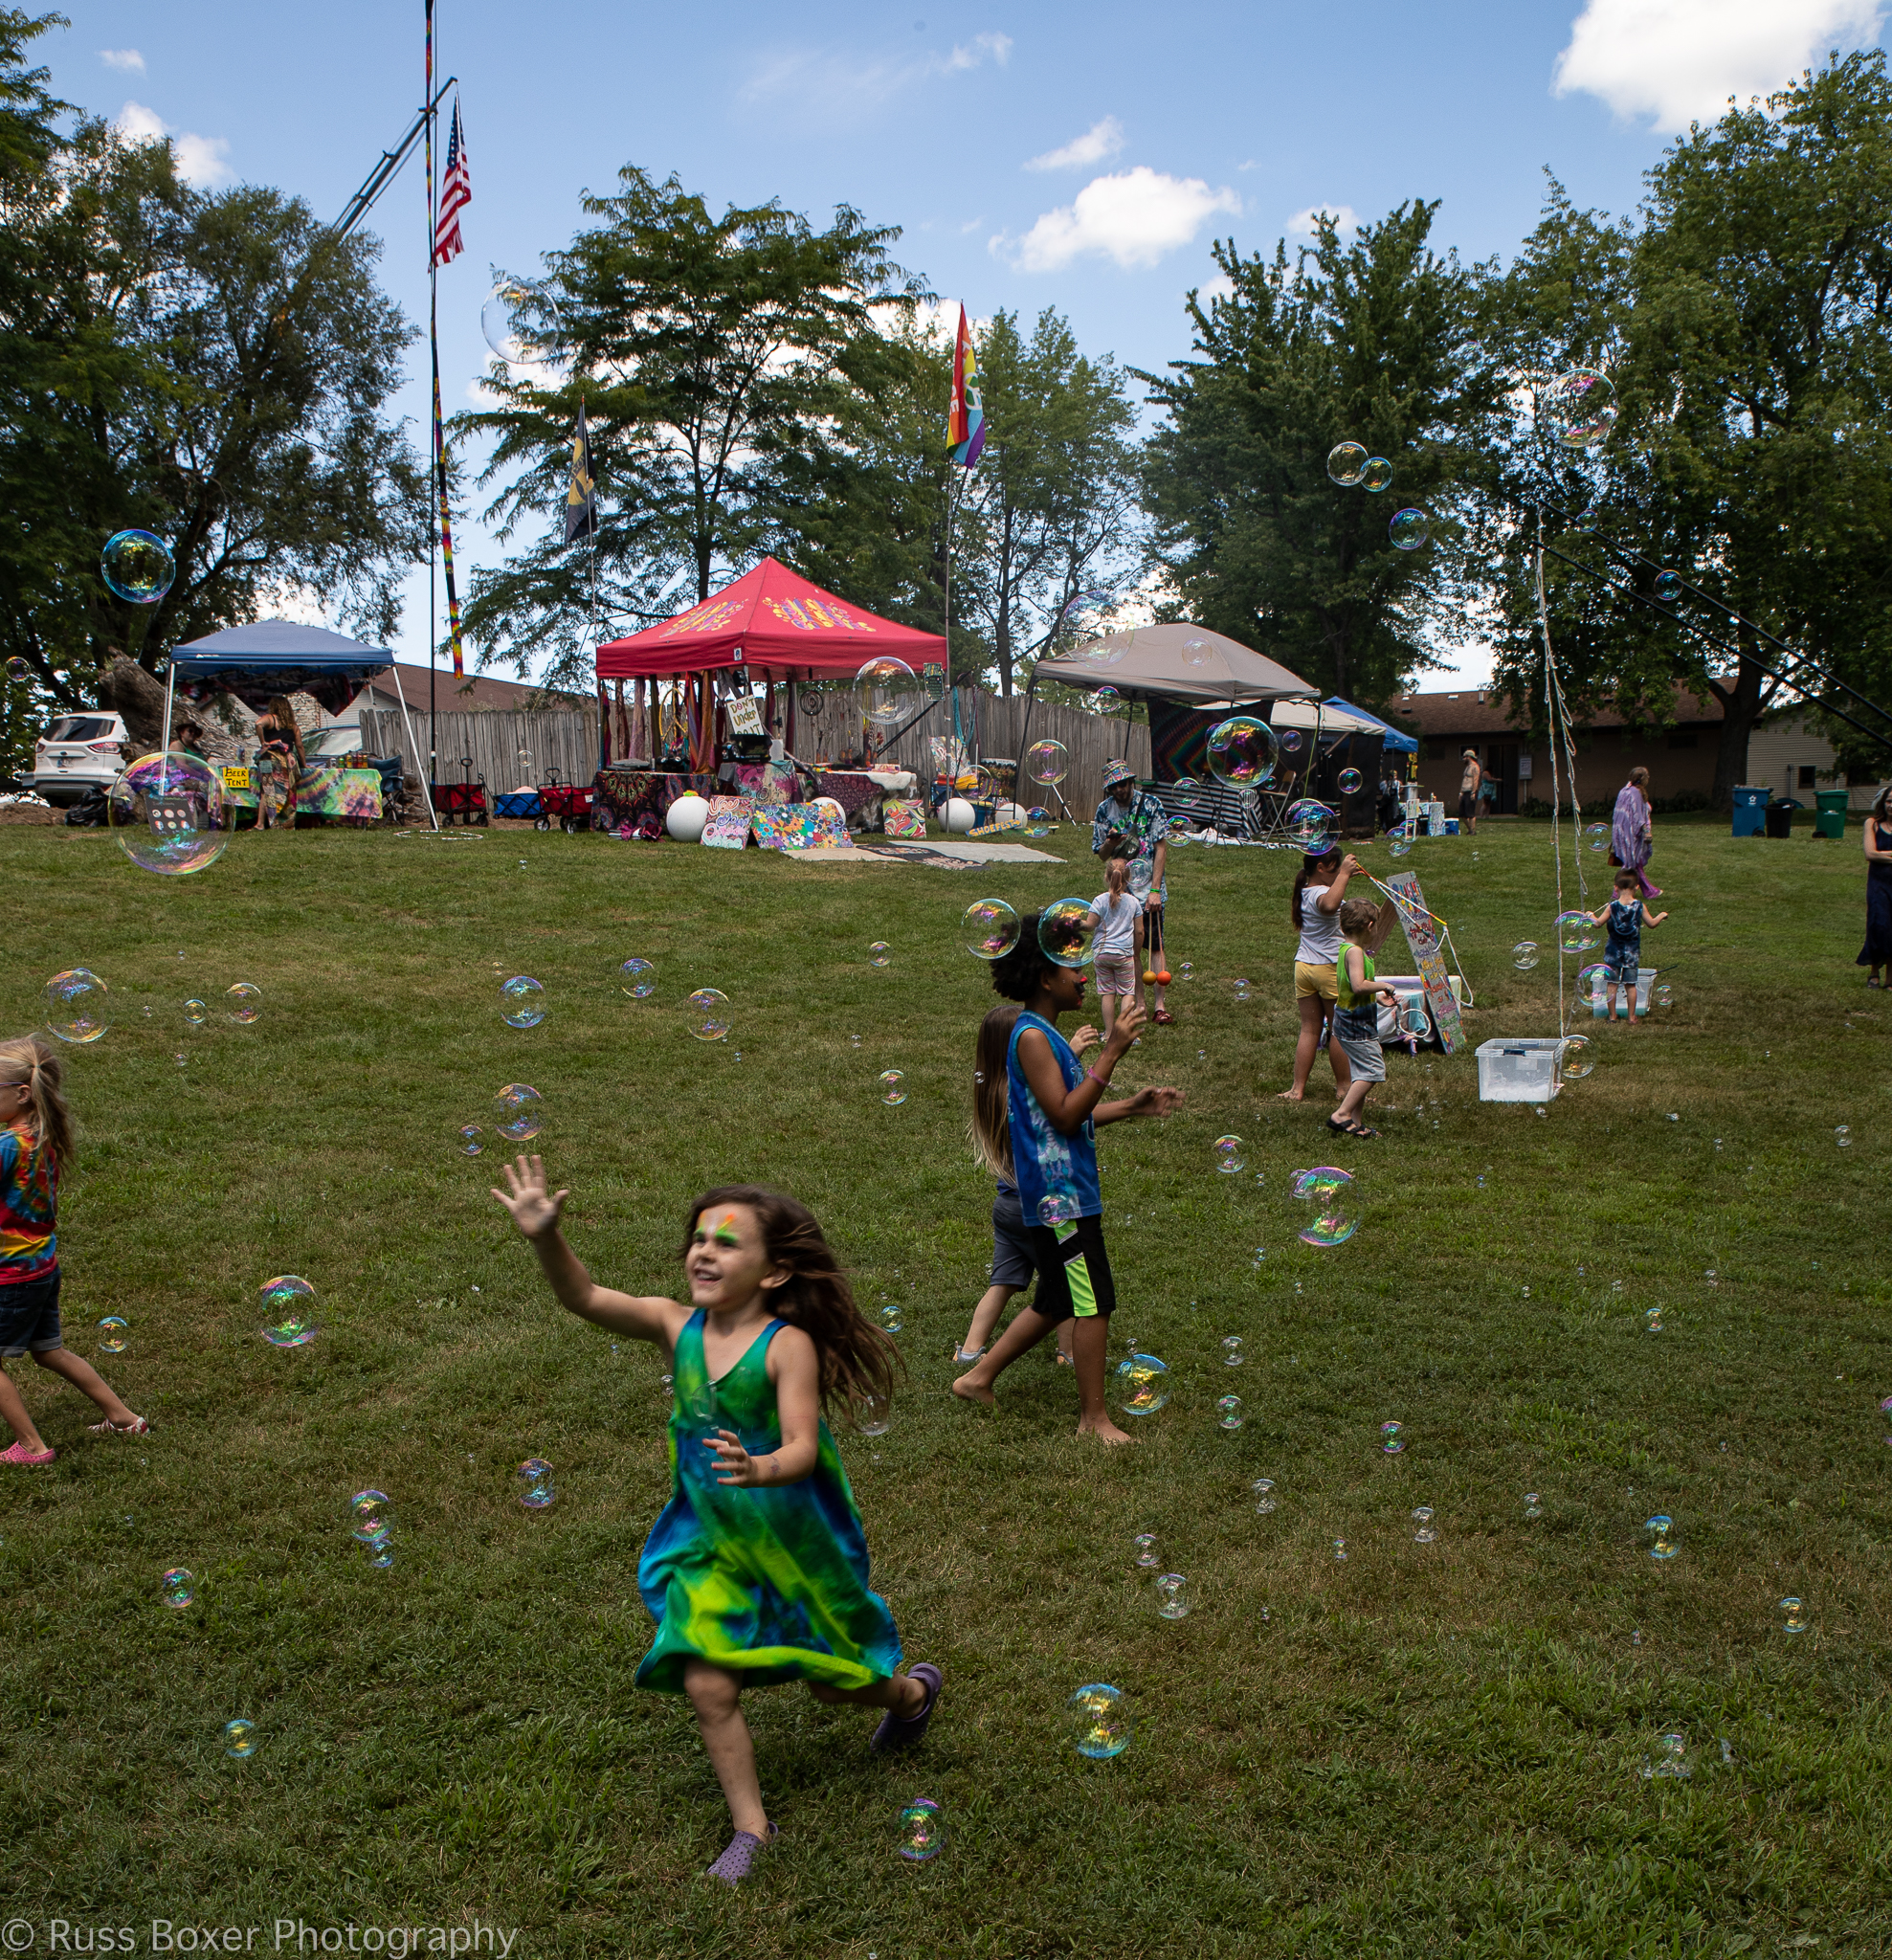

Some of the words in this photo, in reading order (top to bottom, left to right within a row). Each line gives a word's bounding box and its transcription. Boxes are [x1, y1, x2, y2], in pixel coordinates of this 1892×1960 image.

[729, 698, 754, 714] DON'T
[733, 709, 756, 726] Under
[225, 768, 246, 777] BEER
[968, 818, 1015, 836] SHOEFEST
